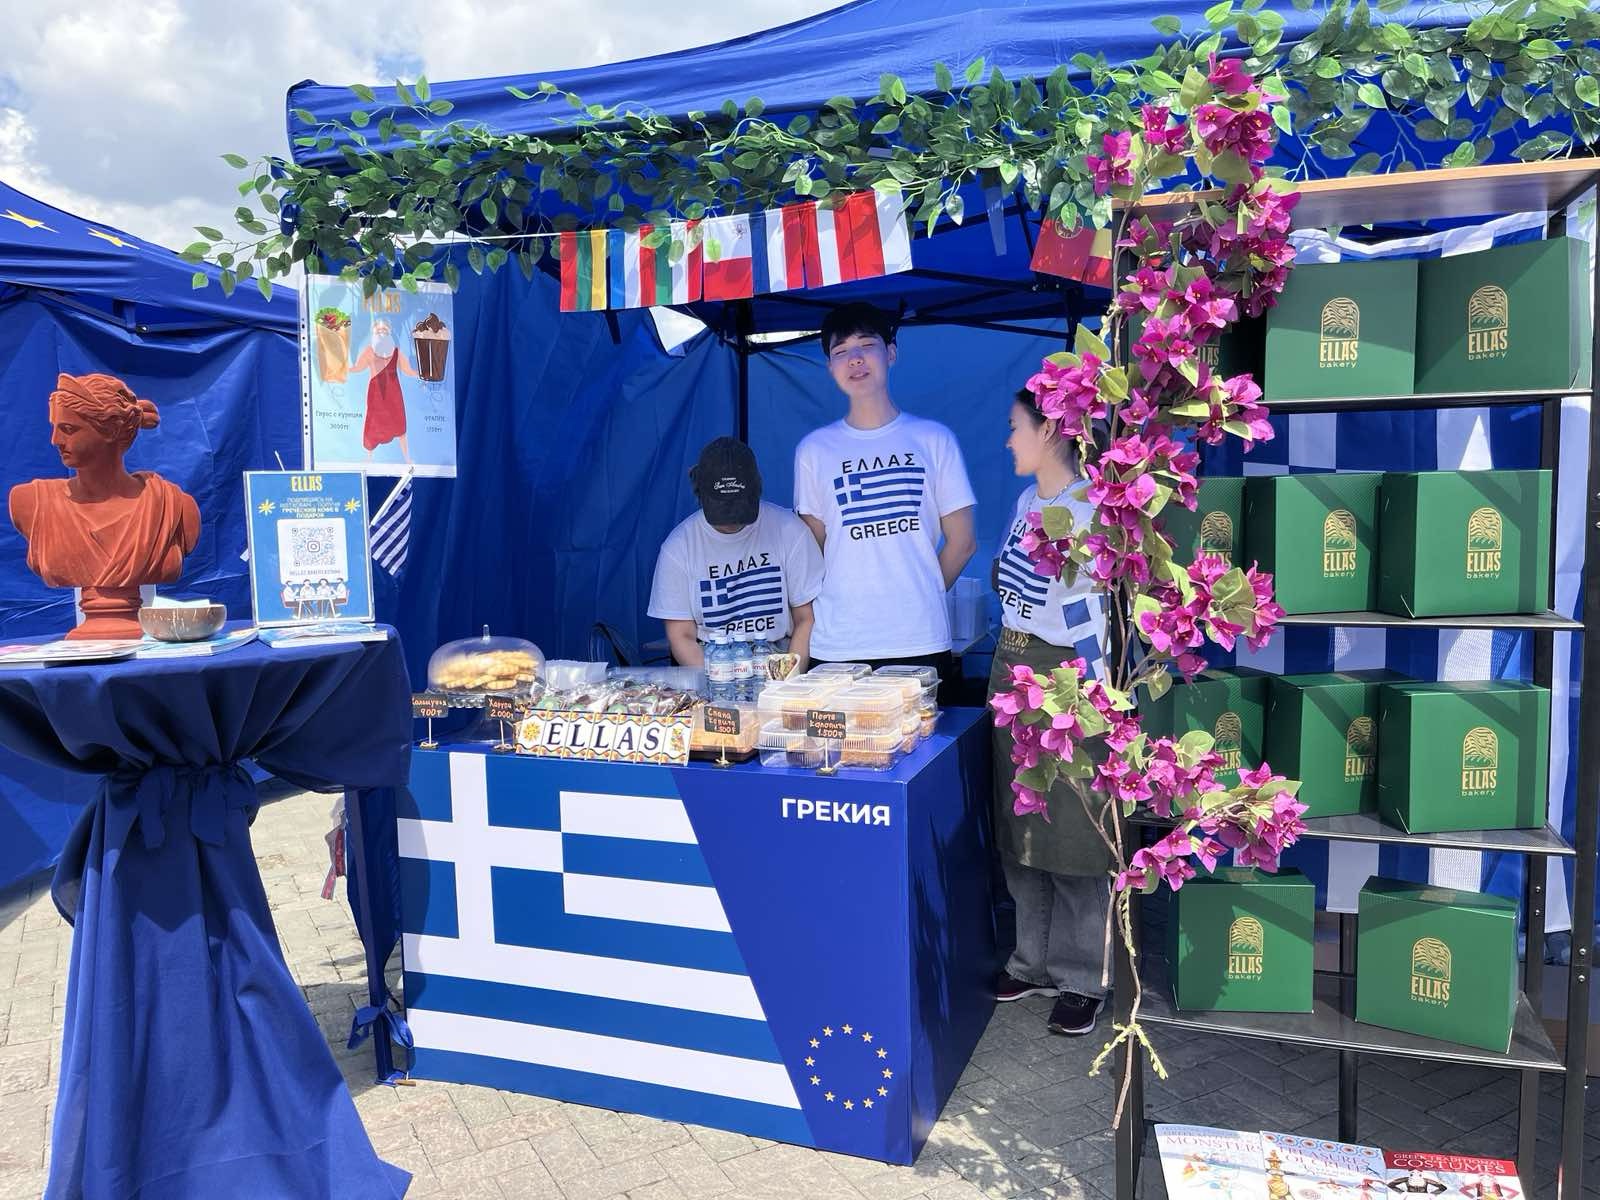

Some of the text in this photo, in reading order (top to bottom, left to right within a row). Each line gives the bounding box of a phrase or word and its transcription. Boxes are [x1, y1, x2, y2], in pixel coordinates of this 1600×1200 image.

[1468, 329, 1509, 354] ELLAS
[1319, 341, 1359, 362] ELLAS
[1468, 351, 1509, 361] bakery
[1319, 361, 1358, 369] bakery
[291, 475, 323, 492] ELLAS
[850, 518, 920, 541] GREECE
[1324, 551, 1357, 571] ELLAS
[1467, 551, 1502, 573] ELLAS
[1323, 570, 1356, 579] bakery
[1466, 572, 1501, 580] bakery
[720, 616, 775, 635] REECE
[547, 722, 660, 750] ELLAS
[1462, 768, 1497, 790] ELLAS
[1461, 789, 1496, 798] bakery
[782, 798, 891, 827] ГРЕКИЯ
[1229, 956, 1263, 975] ELLAS
[1228, 973, 1263, 982] bakery
[1411, 977, 1451, 1001] ELLAS
[1411, 995, 1449, 1009] bakery
[1393, 1158, 1506, 1174] COSTUMES
[1429, 1155, 1501, 1167] TRADITIONAL
